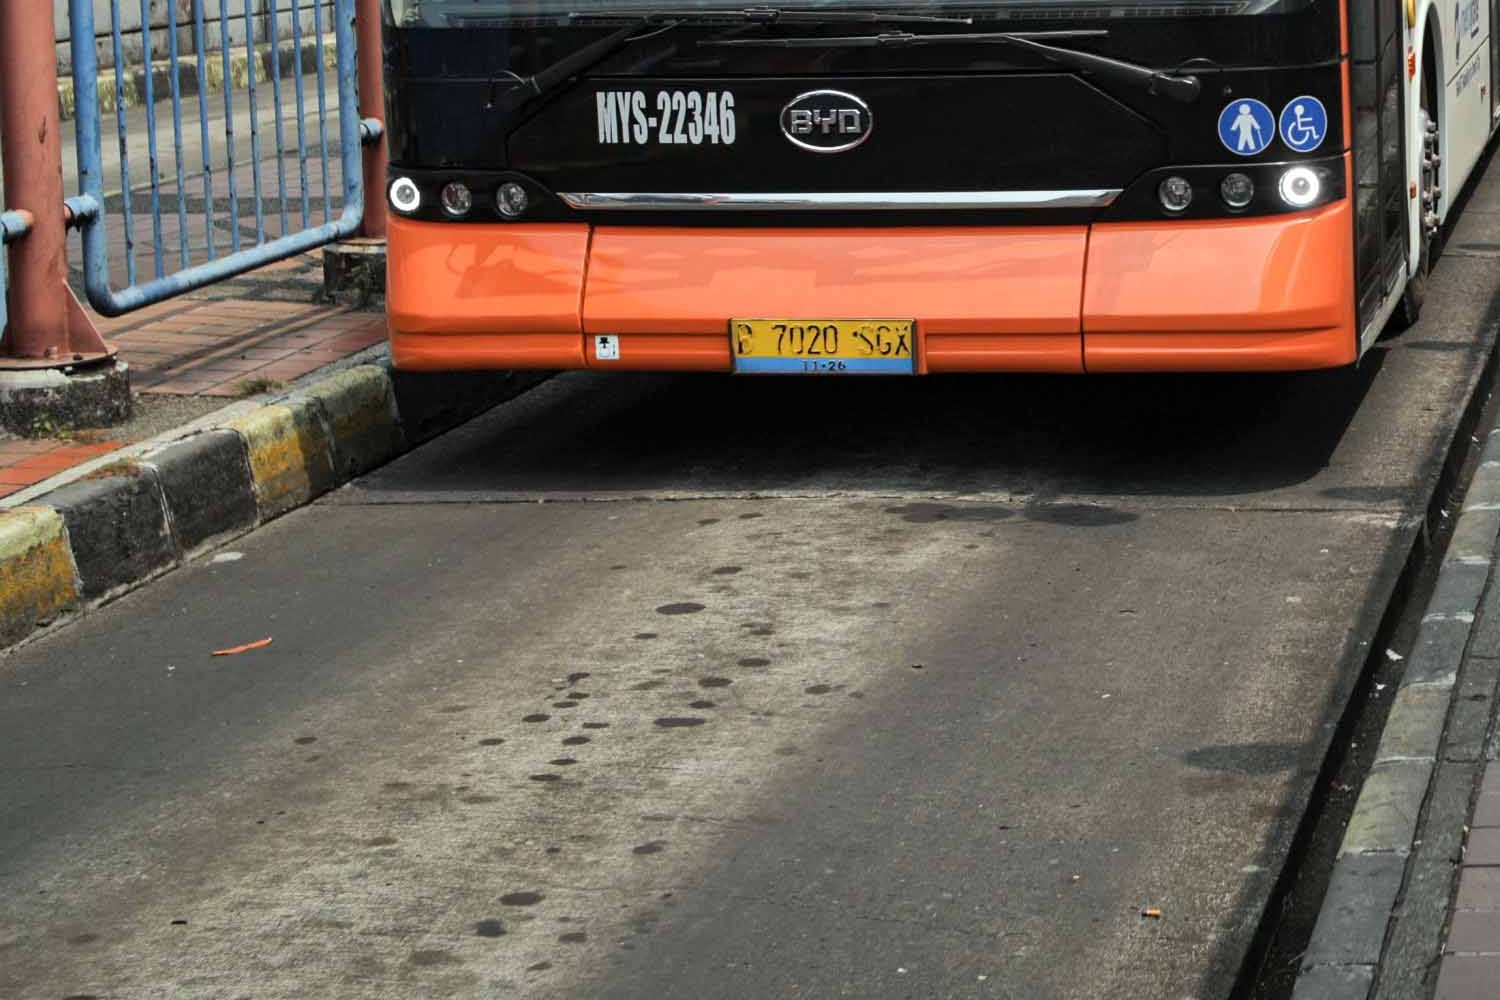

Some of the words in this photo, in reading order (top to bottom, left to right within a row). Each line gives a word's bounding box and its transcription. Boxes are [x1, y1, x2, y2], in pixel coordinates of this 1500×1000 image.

[596, 91, 736, 145] MYS-22346
[790, 108, 862, 135] BYD
[737, 324, 753, 354] B
[772, 324, 838, 355] 7020
[857, 325, 911, 356] SGX
